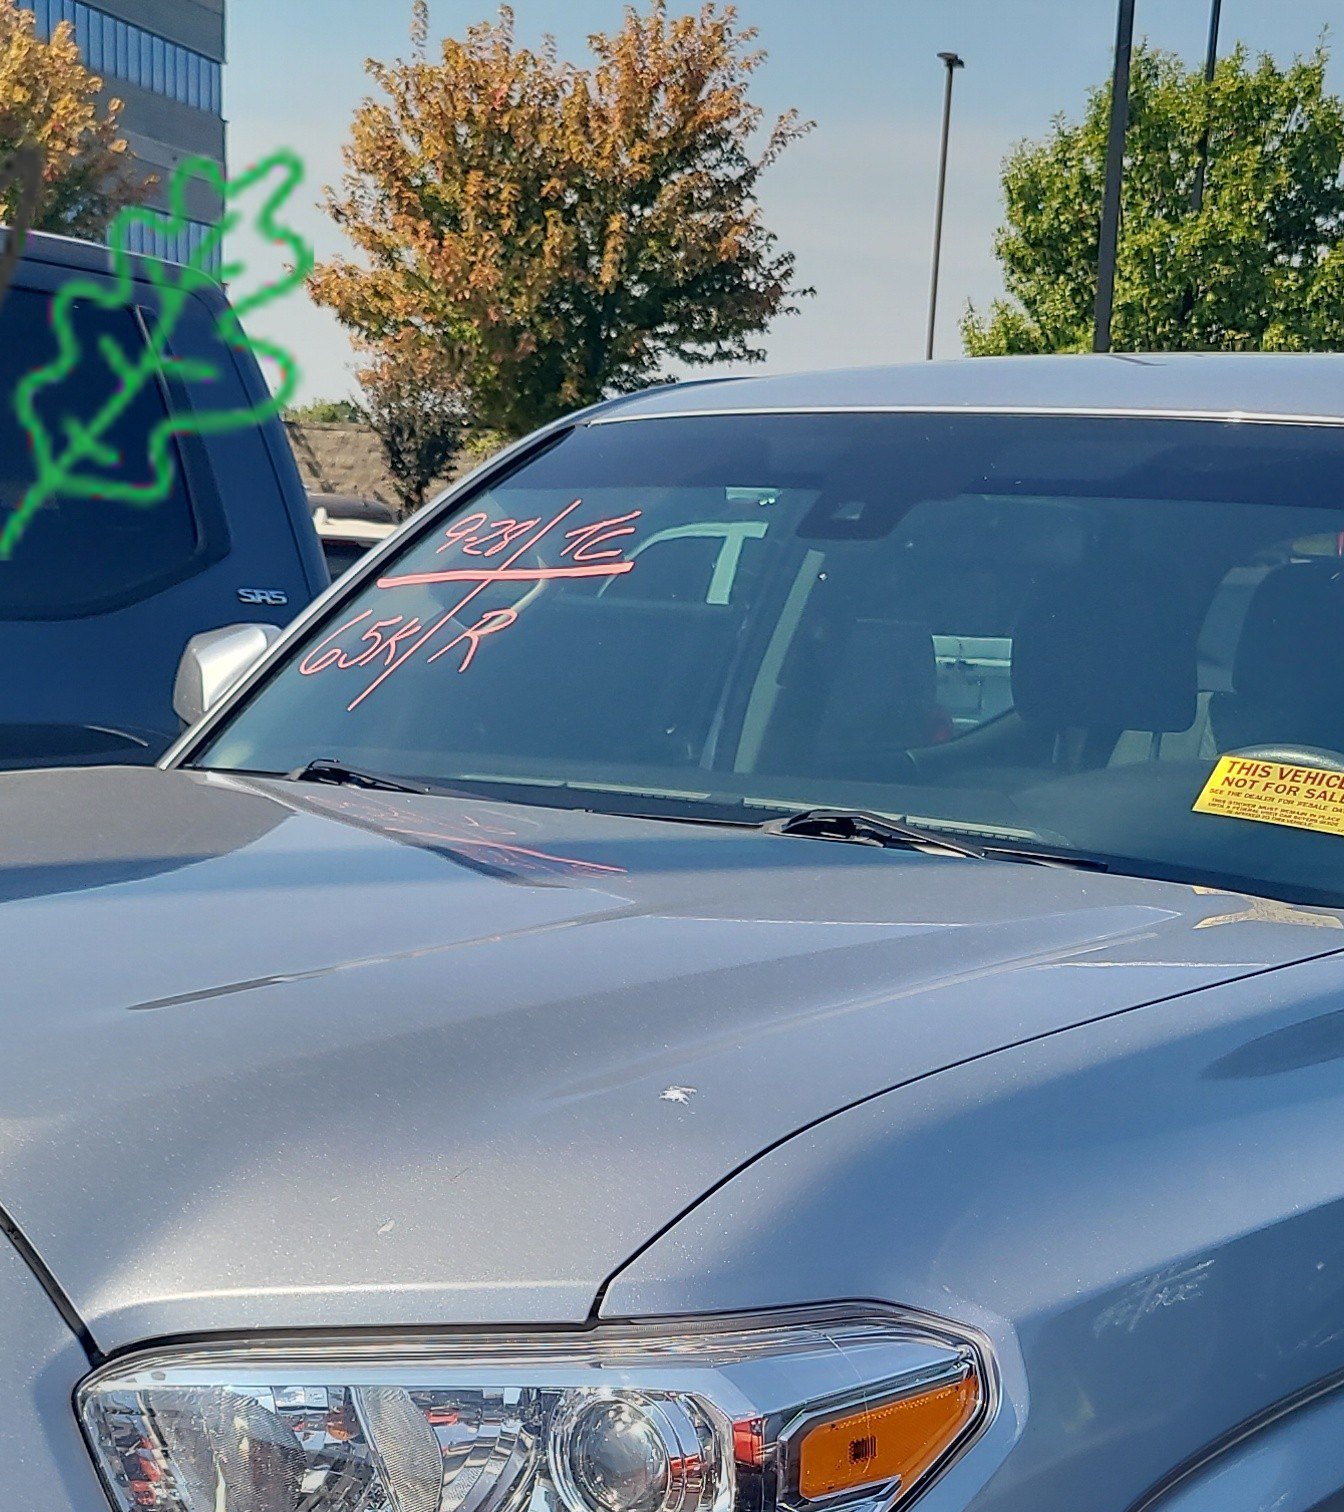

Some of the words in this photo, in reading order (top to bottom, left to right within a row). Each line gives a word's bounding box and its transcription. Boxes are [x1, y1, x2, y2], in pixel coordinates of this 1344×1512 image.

[1225, 760, 1273, 778] THIS
[1221, 777, 1260, 790] NOT
[1262, 781, 1300, 796] FOR
[1243, 793, 1275, 802] DEALER
[1296, 801, 1328, 810] RESALE
